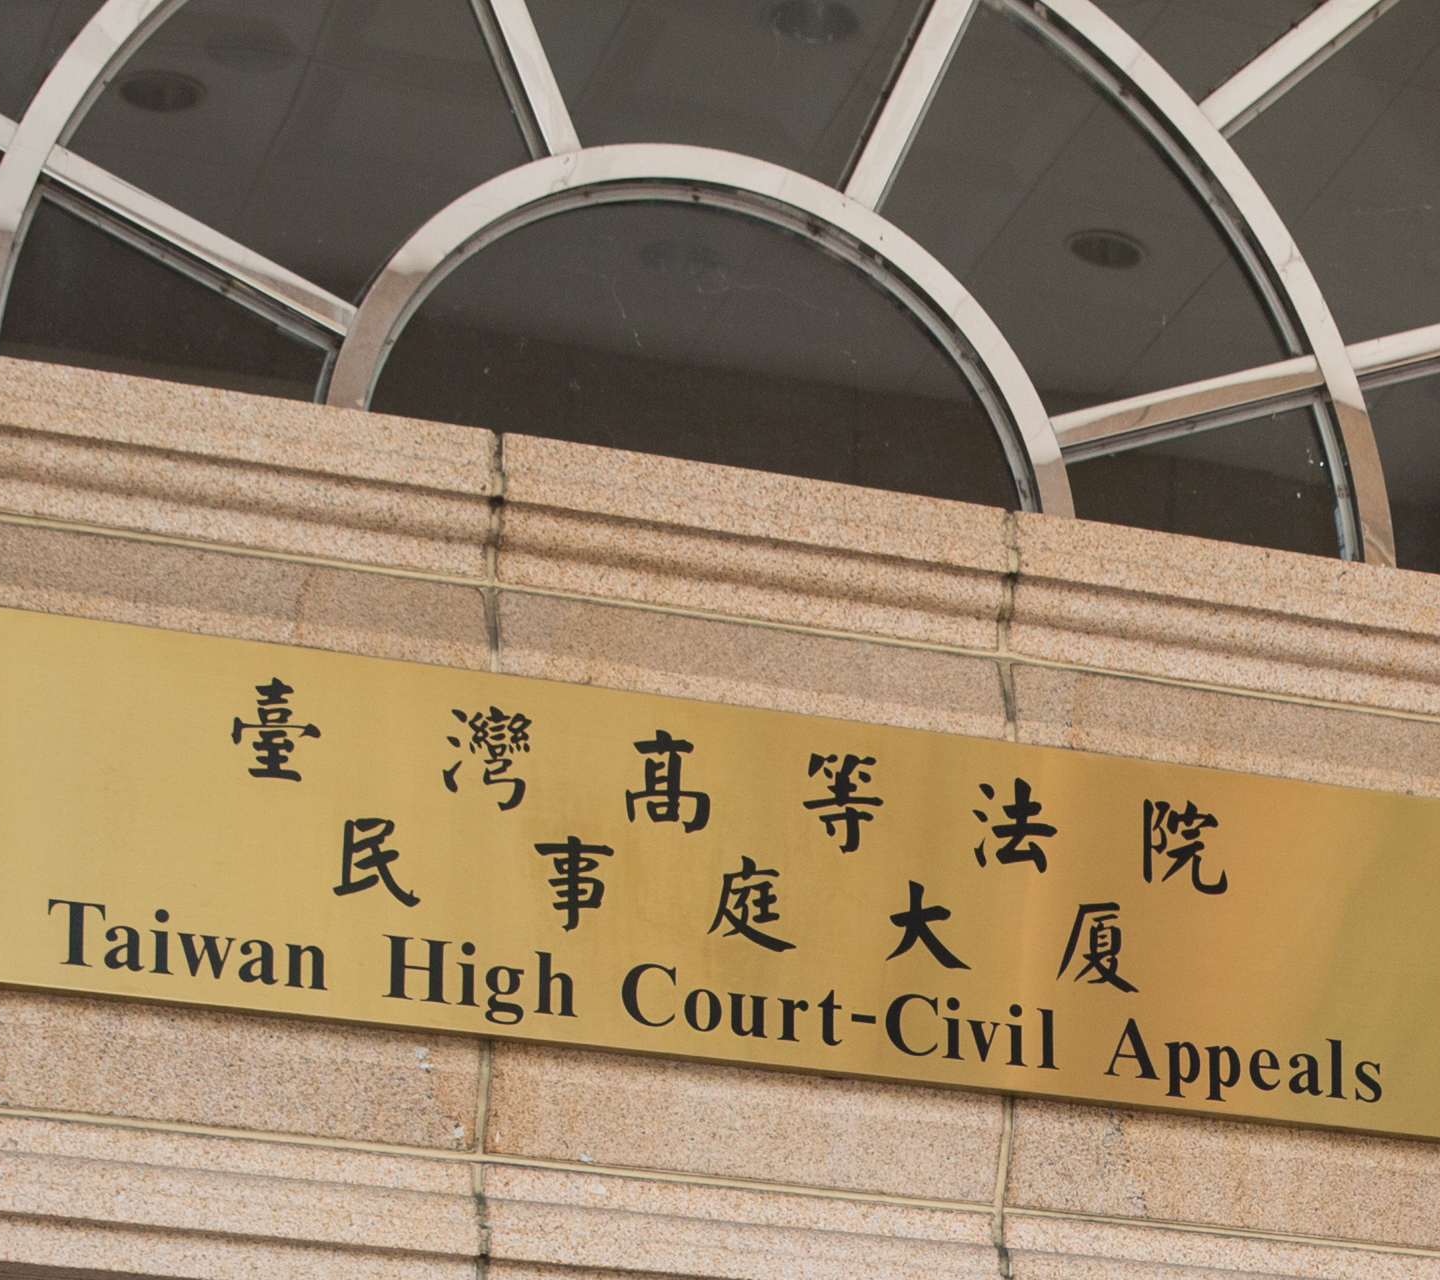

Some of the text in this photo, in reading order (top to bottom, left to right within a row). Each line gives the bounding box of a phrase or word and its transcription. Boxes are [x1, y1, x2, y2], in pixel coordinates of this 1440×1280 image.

[48, 898, 1384, 1105] Taiwan High Court-Civil Appeals
